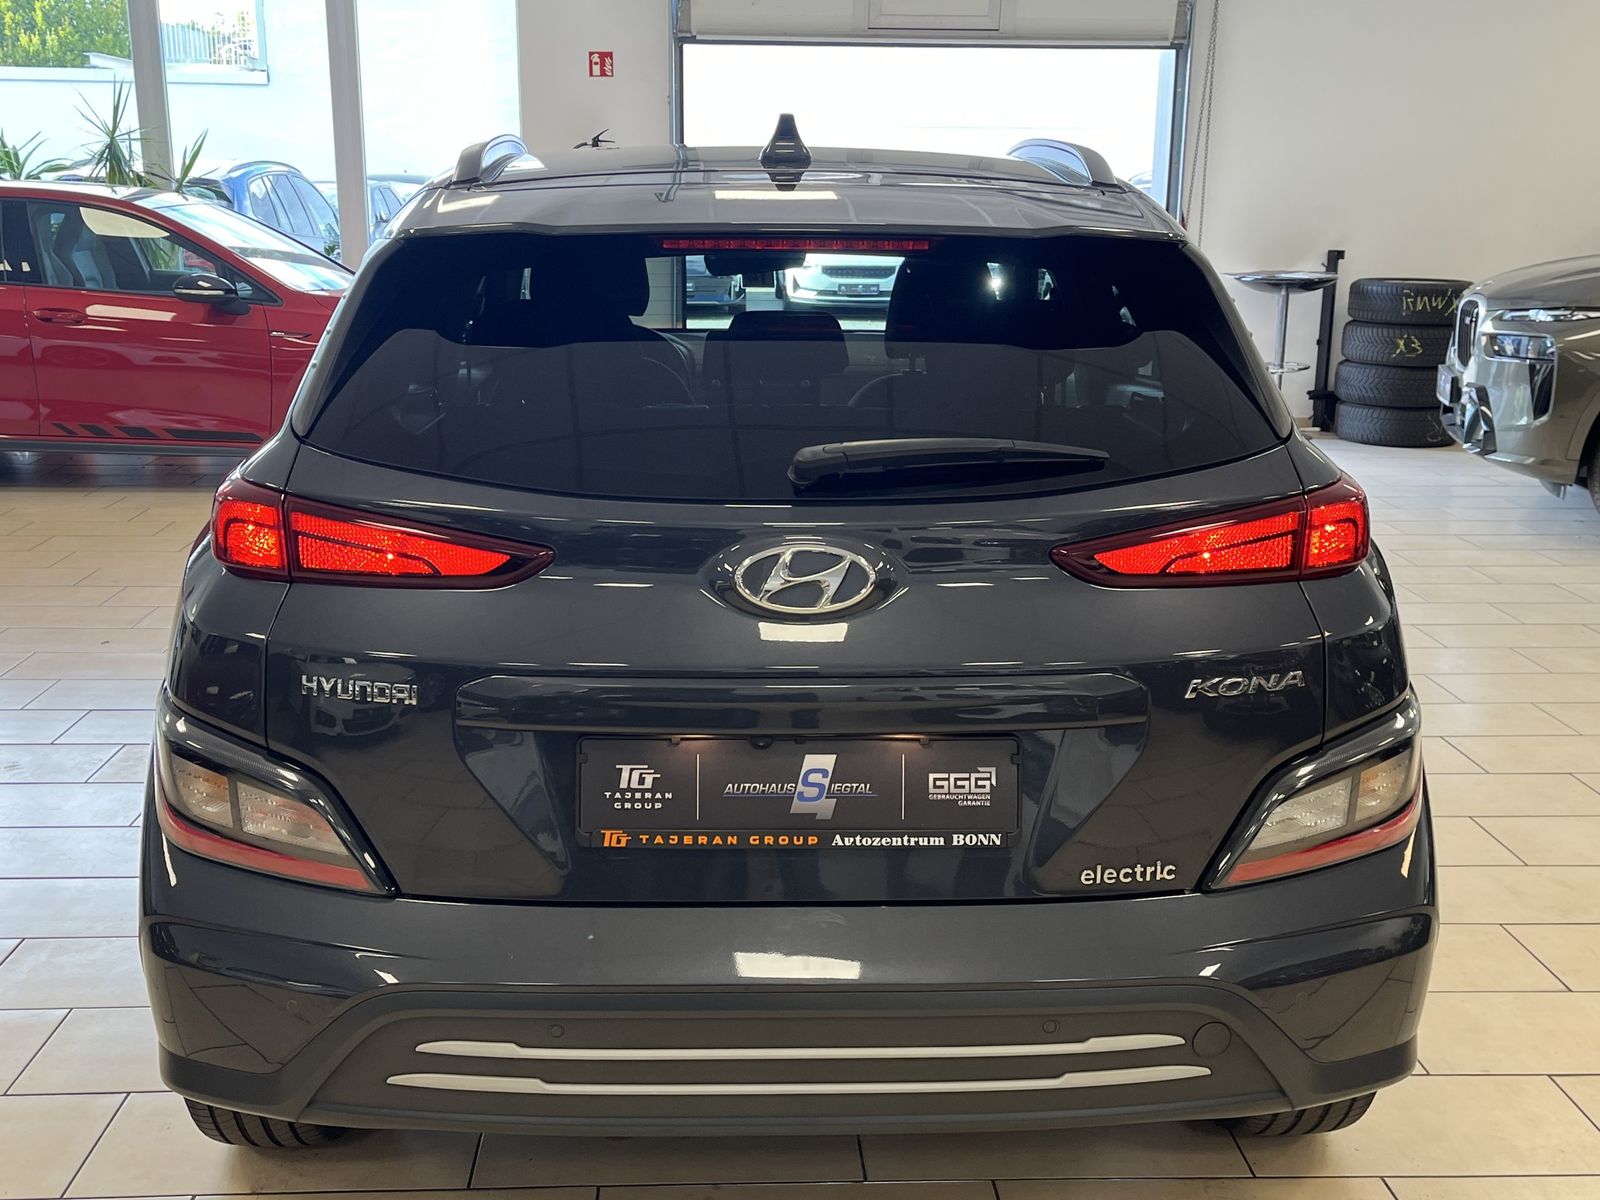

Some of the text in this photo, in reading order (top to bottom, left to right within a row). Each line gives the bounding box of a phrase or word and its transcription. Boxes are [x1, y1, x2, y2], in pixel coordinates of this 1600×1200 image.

[301, 674, 418, 706] HYUNDAI
[1184, 670, 1305, 699] KONA
[723, 783, 797, 794] AUTOHAUS
[928, 772, 991, 794] GGG
[639, 835, 738, 845] TAJERAN
[749, 835, 819, 845] GROUP
[951, 833, 1002, 846] BONN
[1080, 860, 1177, 885] electric
